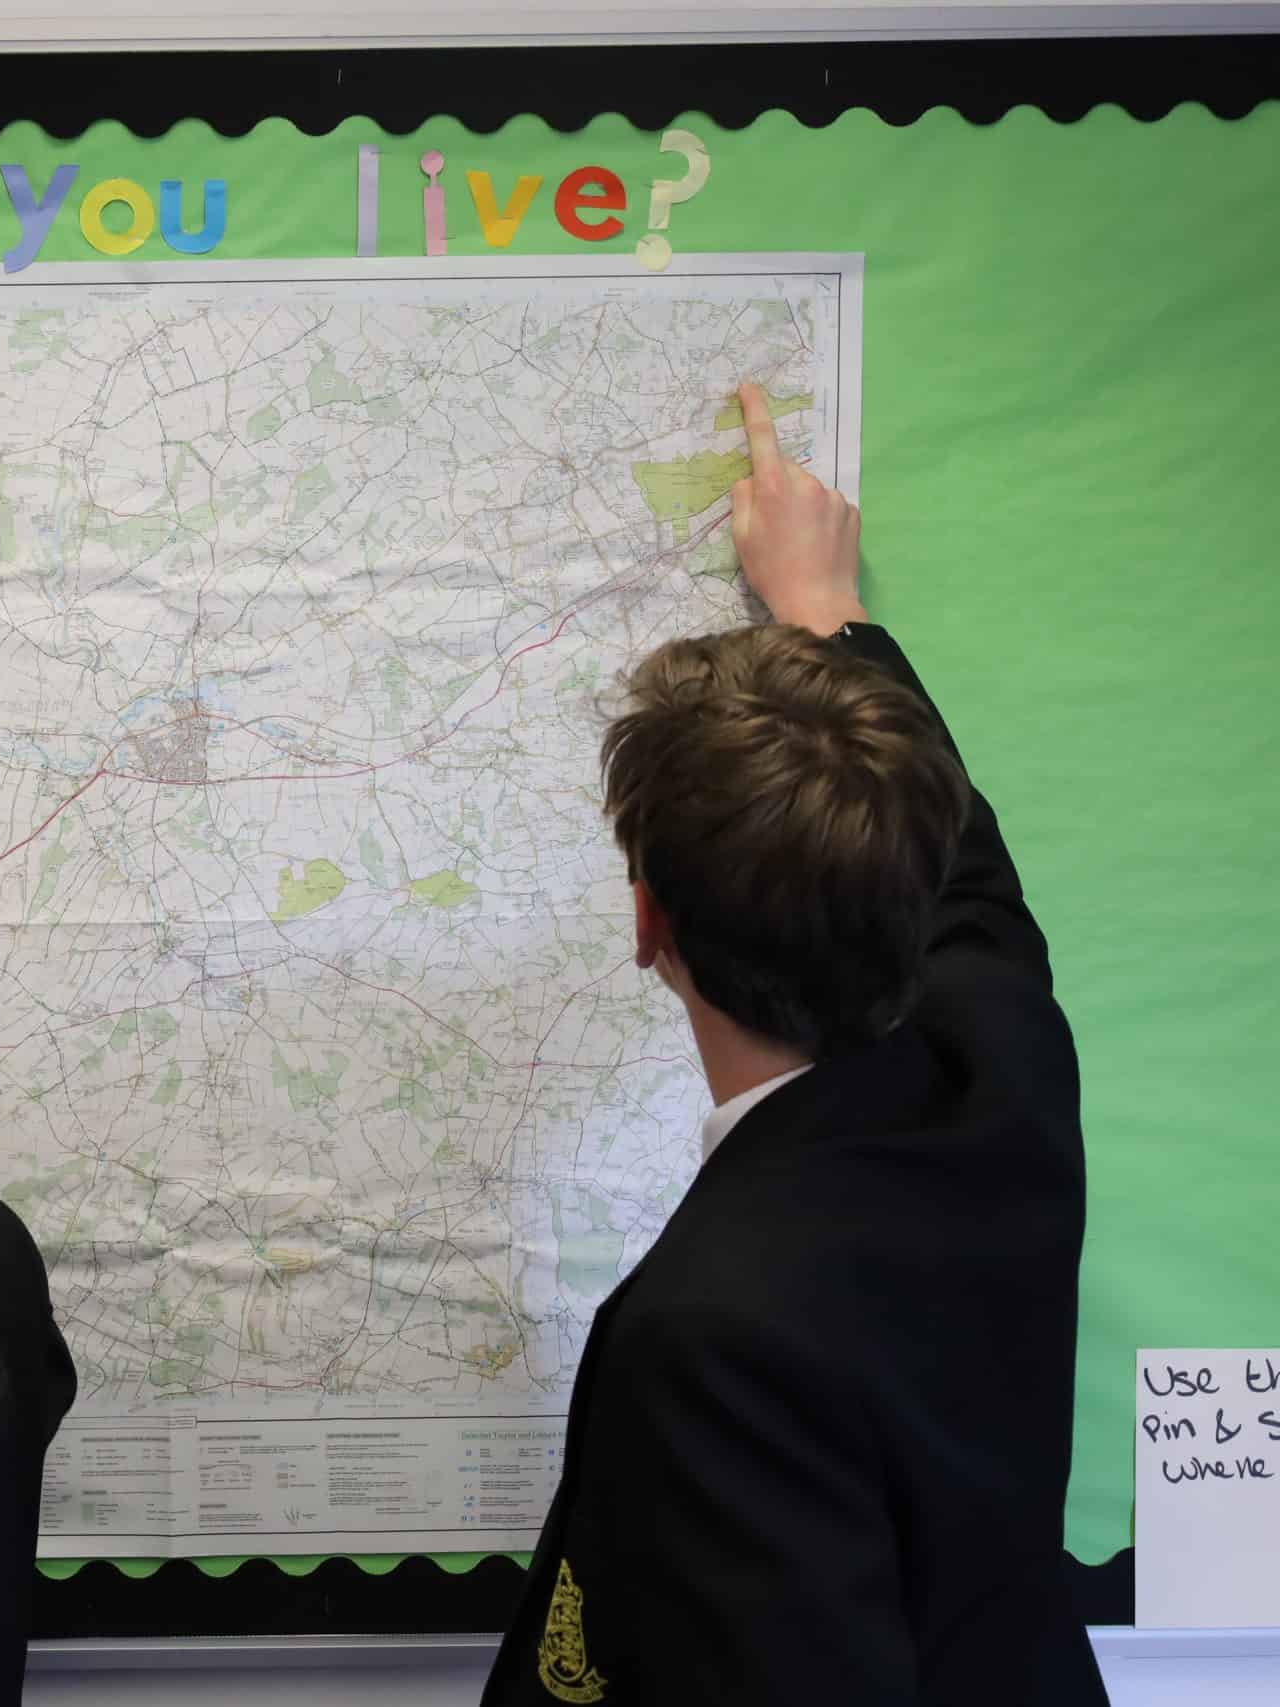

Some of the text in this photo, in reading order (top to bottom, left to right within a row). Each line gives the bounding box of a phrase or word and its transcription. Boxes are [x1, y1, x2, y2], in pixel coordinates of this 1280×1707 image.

[0, 164, 227, 274] you
[357, 129, 712, 272] live?
[1143, 1366, 1220, 1397] Use
